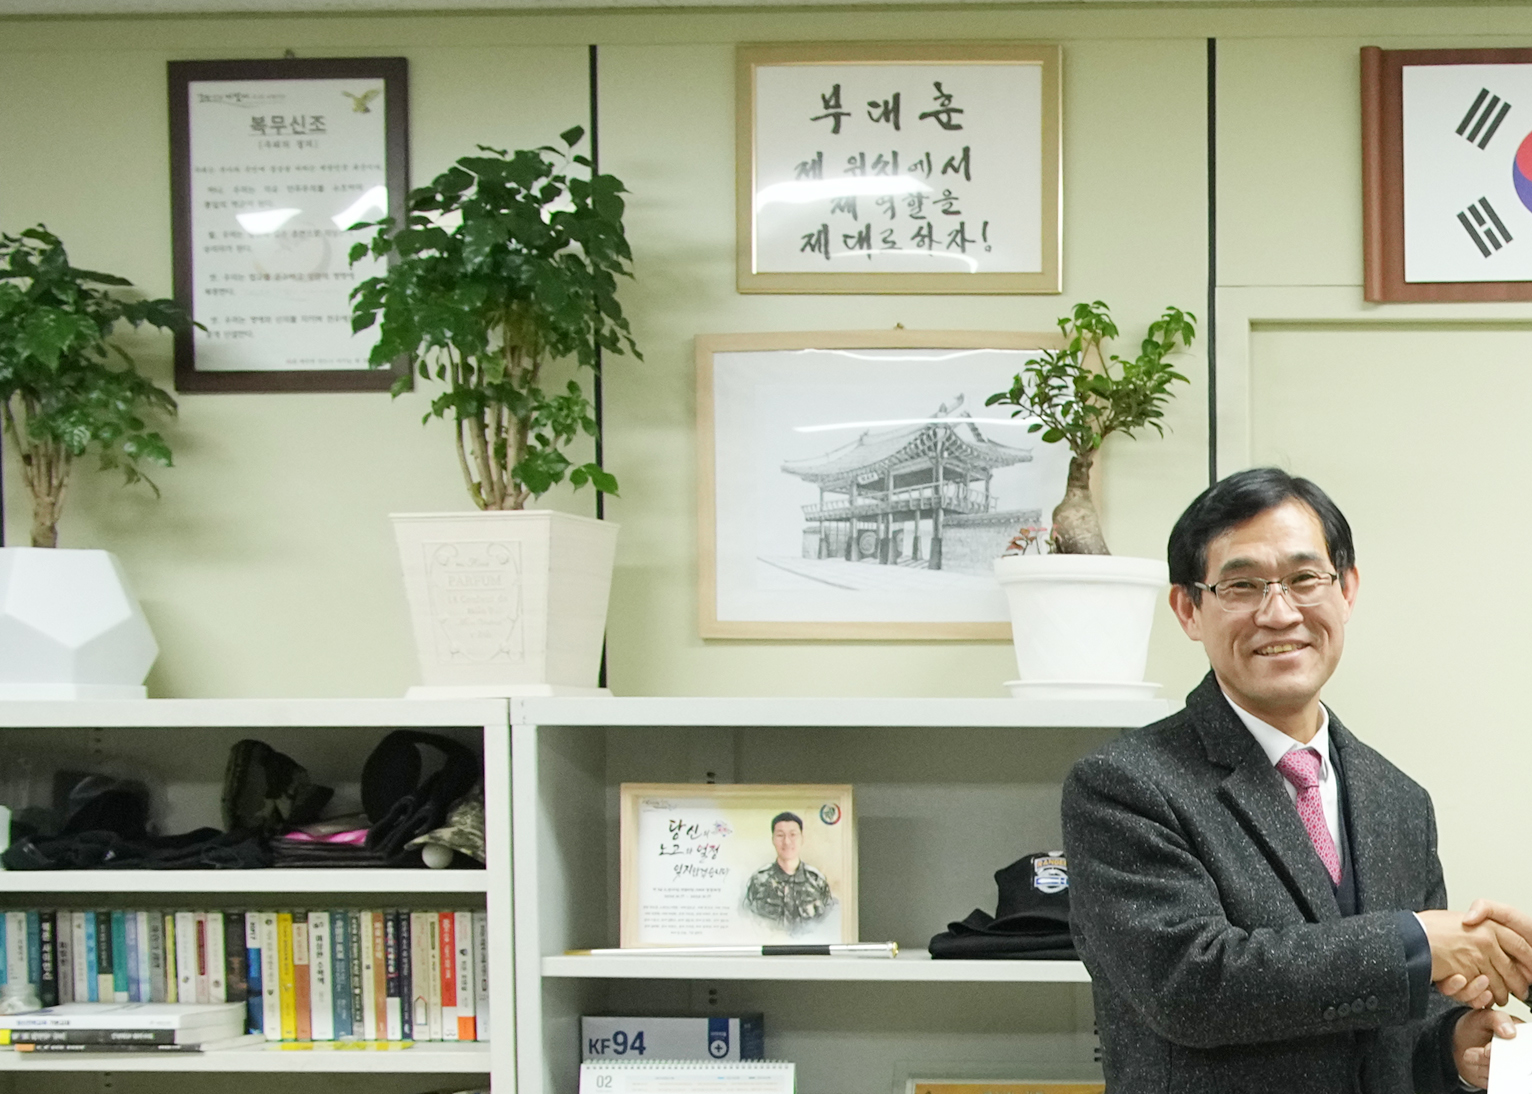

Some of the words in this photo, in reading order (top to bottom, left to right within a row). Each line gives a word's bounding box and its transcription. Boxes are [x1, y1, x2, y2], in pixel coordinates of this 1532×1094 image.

[250, 115, 326, 134] 복무신조
[588, 1031, 646, 1055] KF94
[596, 1075, 612, 1088] 02
